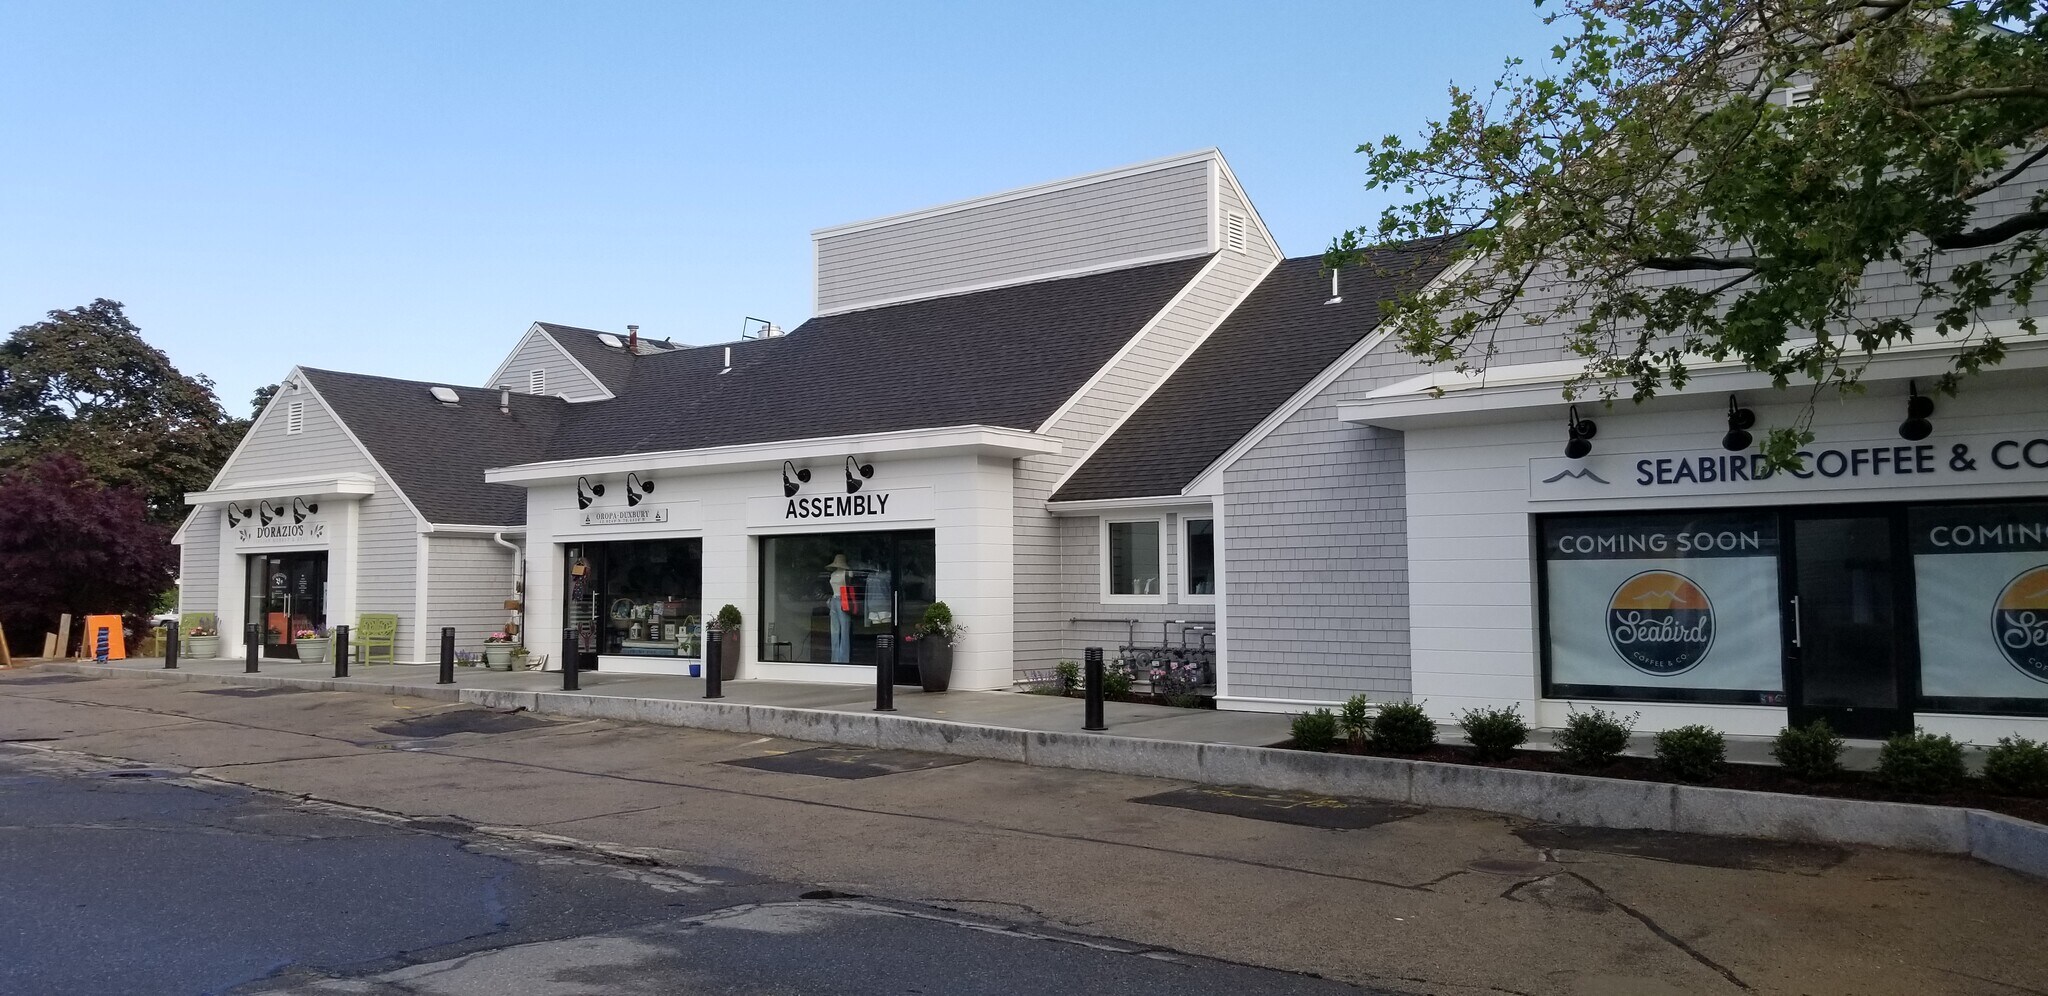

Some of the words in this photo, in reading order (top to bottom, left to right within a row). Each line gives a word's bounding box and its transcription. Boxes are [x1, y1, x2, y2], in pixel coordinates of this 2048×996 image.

[1636, 455, 1775, 486] SEABIRD
[1789, 444, 1935, 479] COFFEE
[1949, 443, 1977, 472] &
[785, 493, 890, 519] ASSEMBLY
[257, 525, 304, 538] D'ORAZIO'S
[1558, 533, 1668, 554] COMING
[1676, 530, 1760, 551] SOON
[1929, 522, 2048, 547] COMIN
[1615, 610, 1707, 644] Seabird
[1633, 651, 1665, 667] COFFEE
